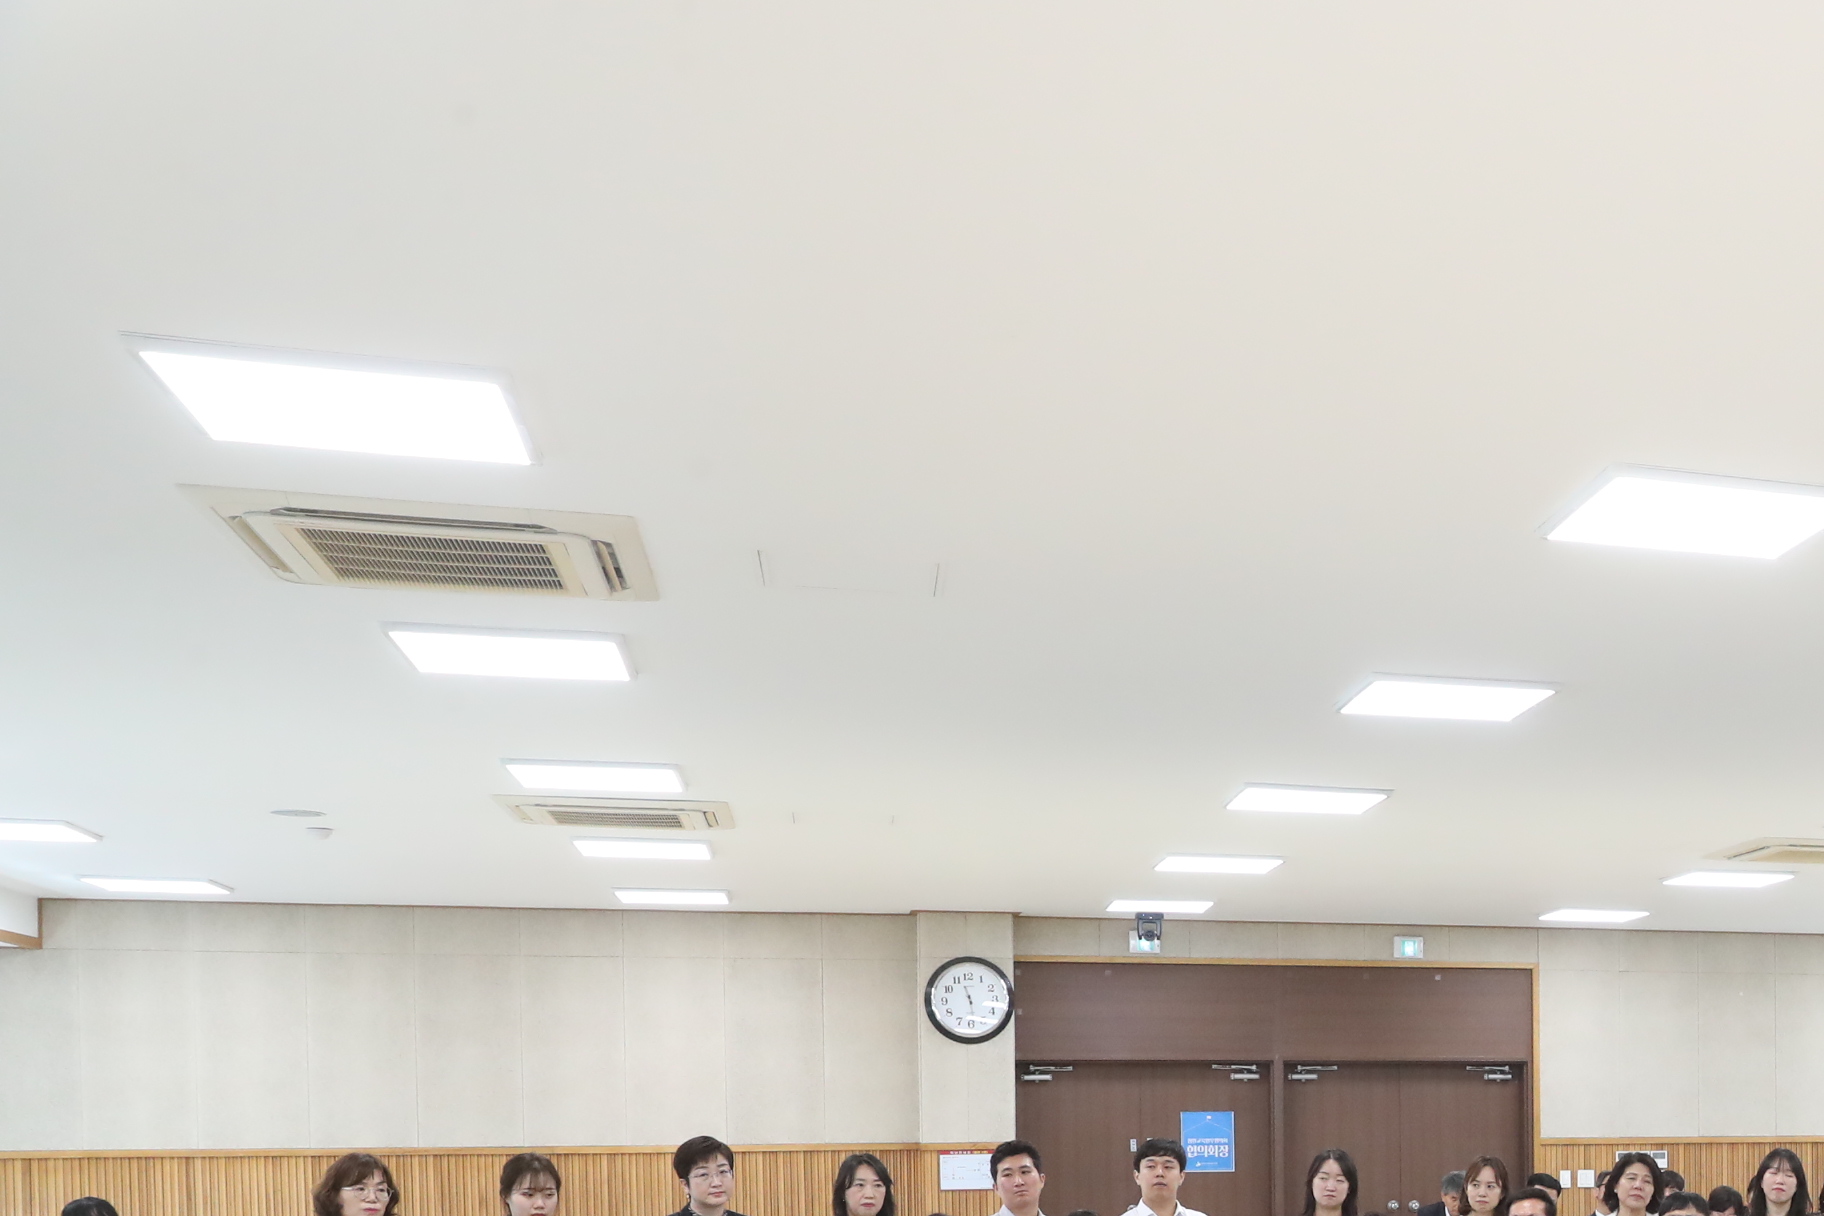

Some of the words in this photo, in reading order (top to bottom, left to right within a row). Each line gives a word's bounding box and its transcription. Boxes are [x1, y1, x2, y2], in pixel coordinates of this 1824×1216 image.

[952, 976, 962, 984] 11
[963, 972, 974, 981] 12
[979, 975, 984, 983] 1
[944, 985, 954, 994] 10
[987, 984, 995, 993] 2
[941, 997, 949, 1006] 9
[945, 1008, 953, 1017] 8
[988, 1007, 996, 1016] 4
[955, 1017, 963, 1026] 7
[967, 1020, 975, 1029] 6
